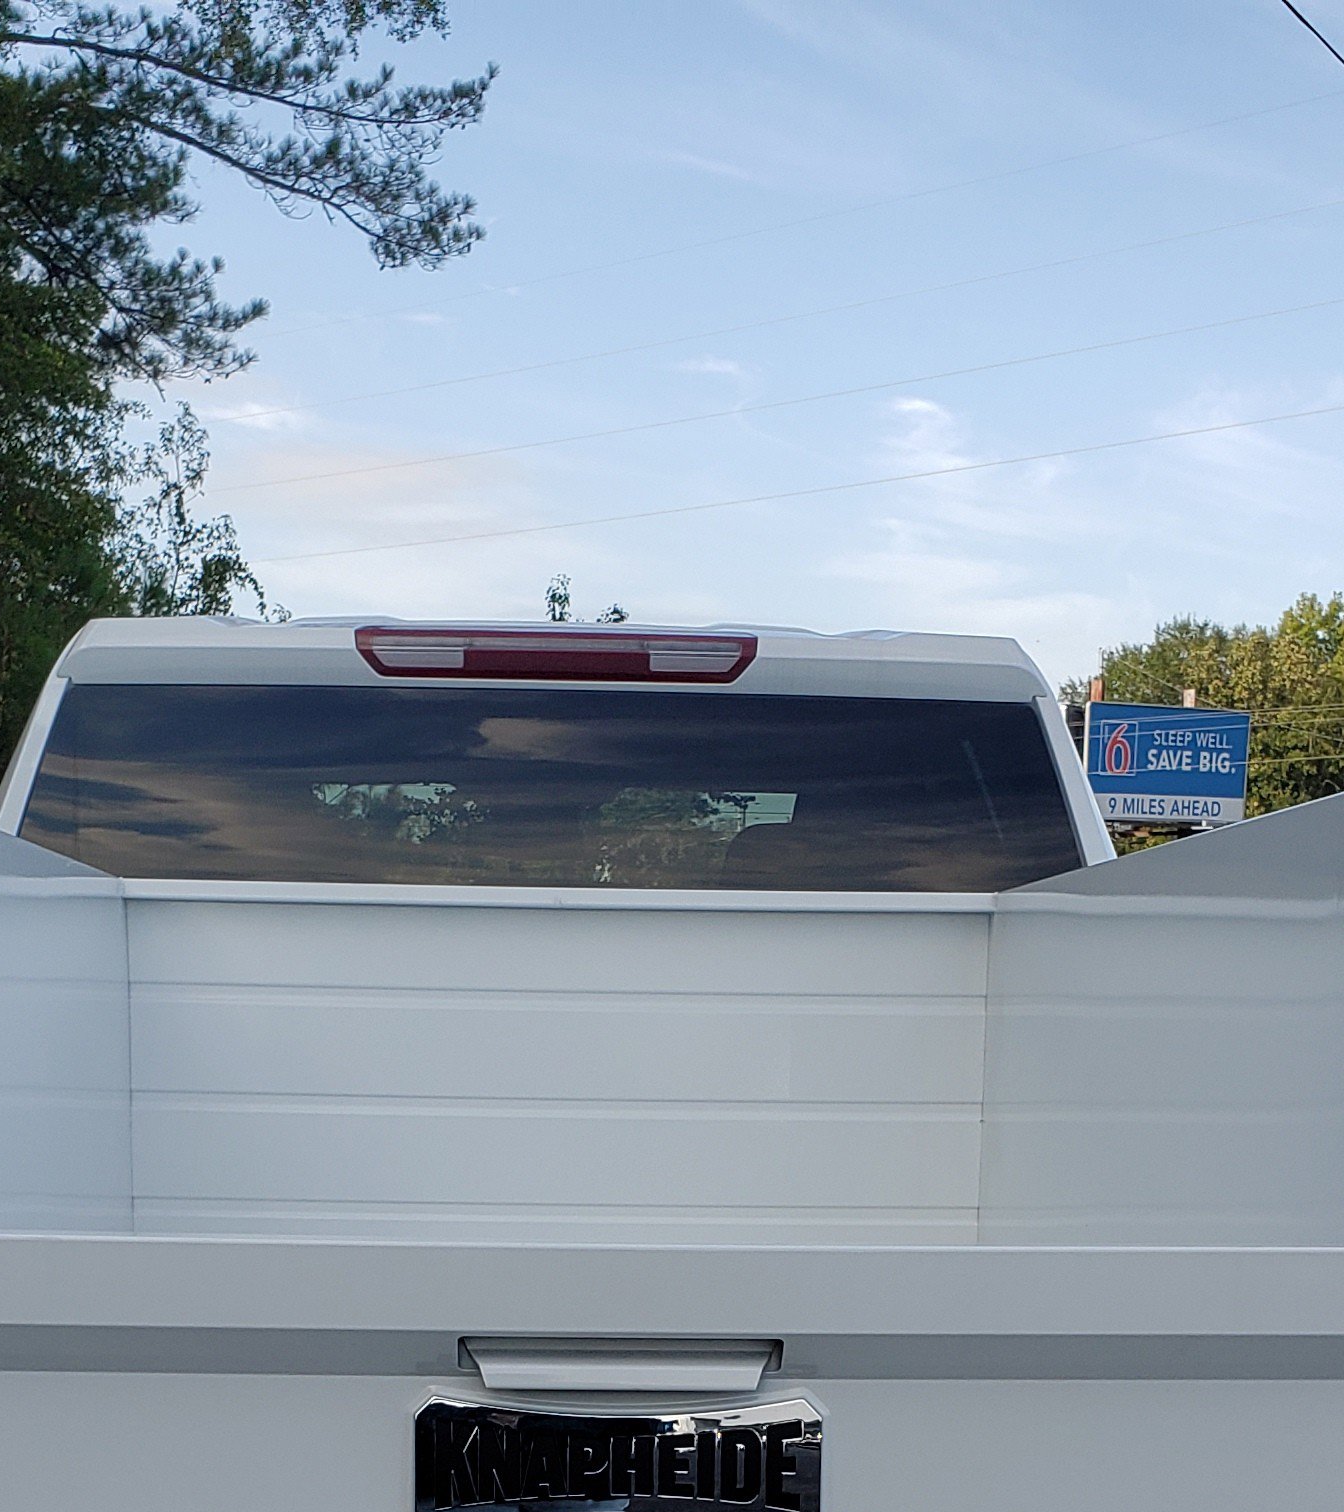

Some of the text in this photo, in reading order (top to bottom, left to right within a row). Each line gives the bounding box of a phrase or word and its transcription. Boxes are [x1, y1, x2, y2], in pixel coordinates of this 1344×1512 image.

[1106, 723, 1131, 775] 6
[1153, 730, 1233, 749] SLEEP WELL.
[1147, 749, 1236, 774] SAVE BIG.
[1108, 797, 1221, 817] 9 MILES AHEAD
